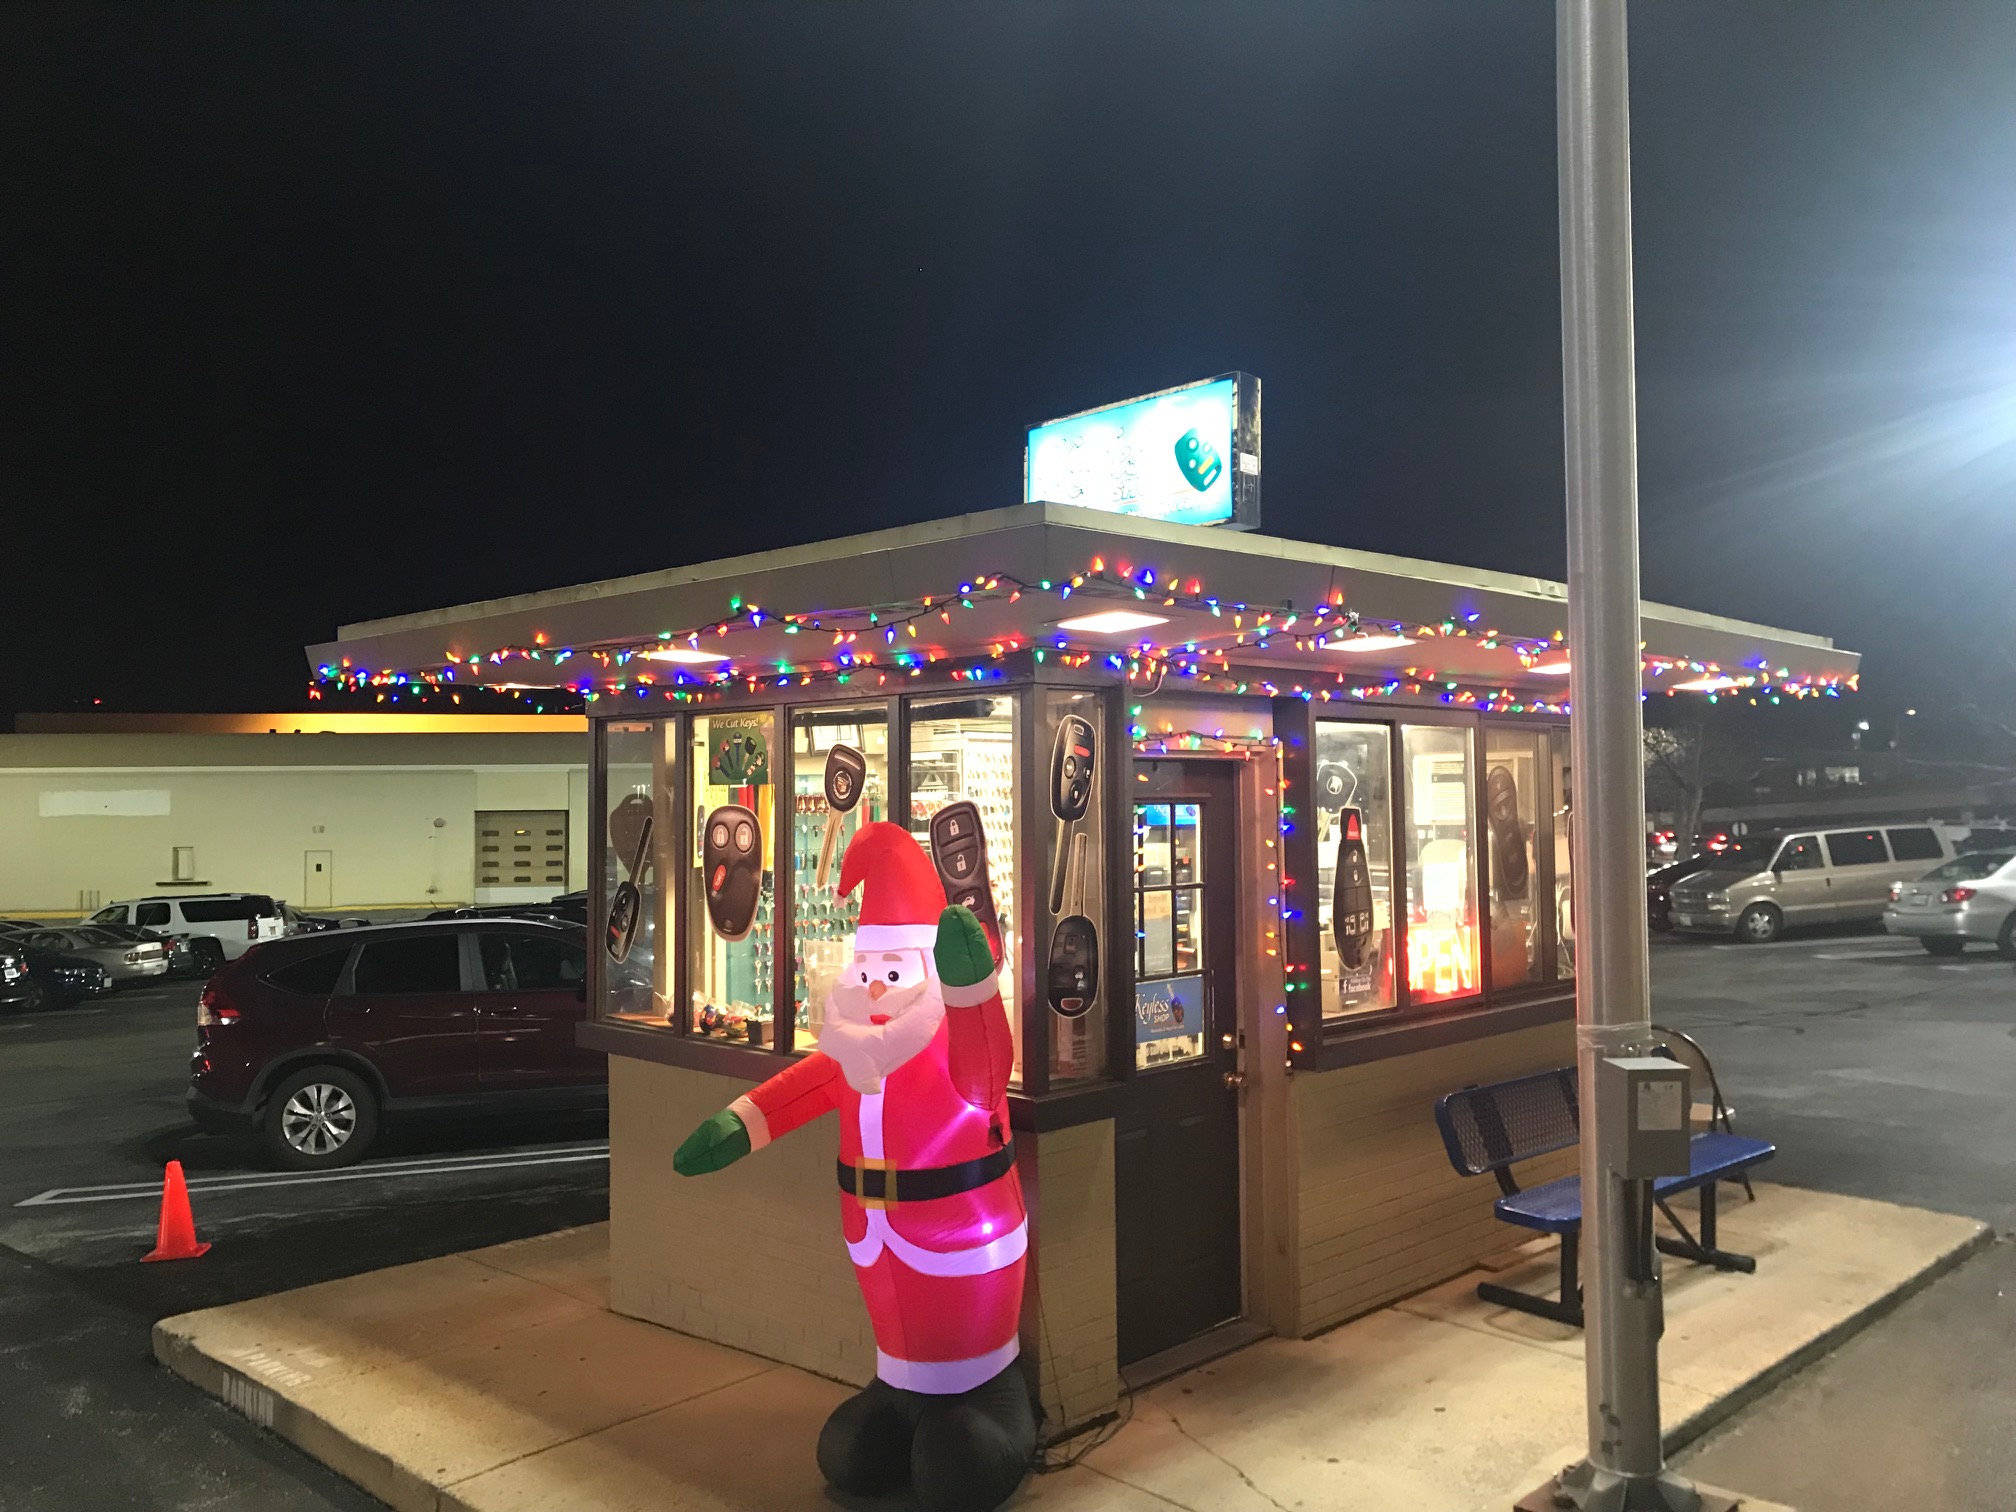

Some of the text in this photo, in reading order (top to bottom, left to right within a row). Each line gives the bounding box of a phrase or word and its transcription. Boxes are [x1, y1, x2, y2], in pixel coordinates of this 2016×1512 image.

[712, 717, 759, 730] We Cut Keys!
[1348, 982, 1371, 993] facebook
[1135, 992, 1170, 1025] Keyless
[1153, 1013, 1170, 1024] SHOP
